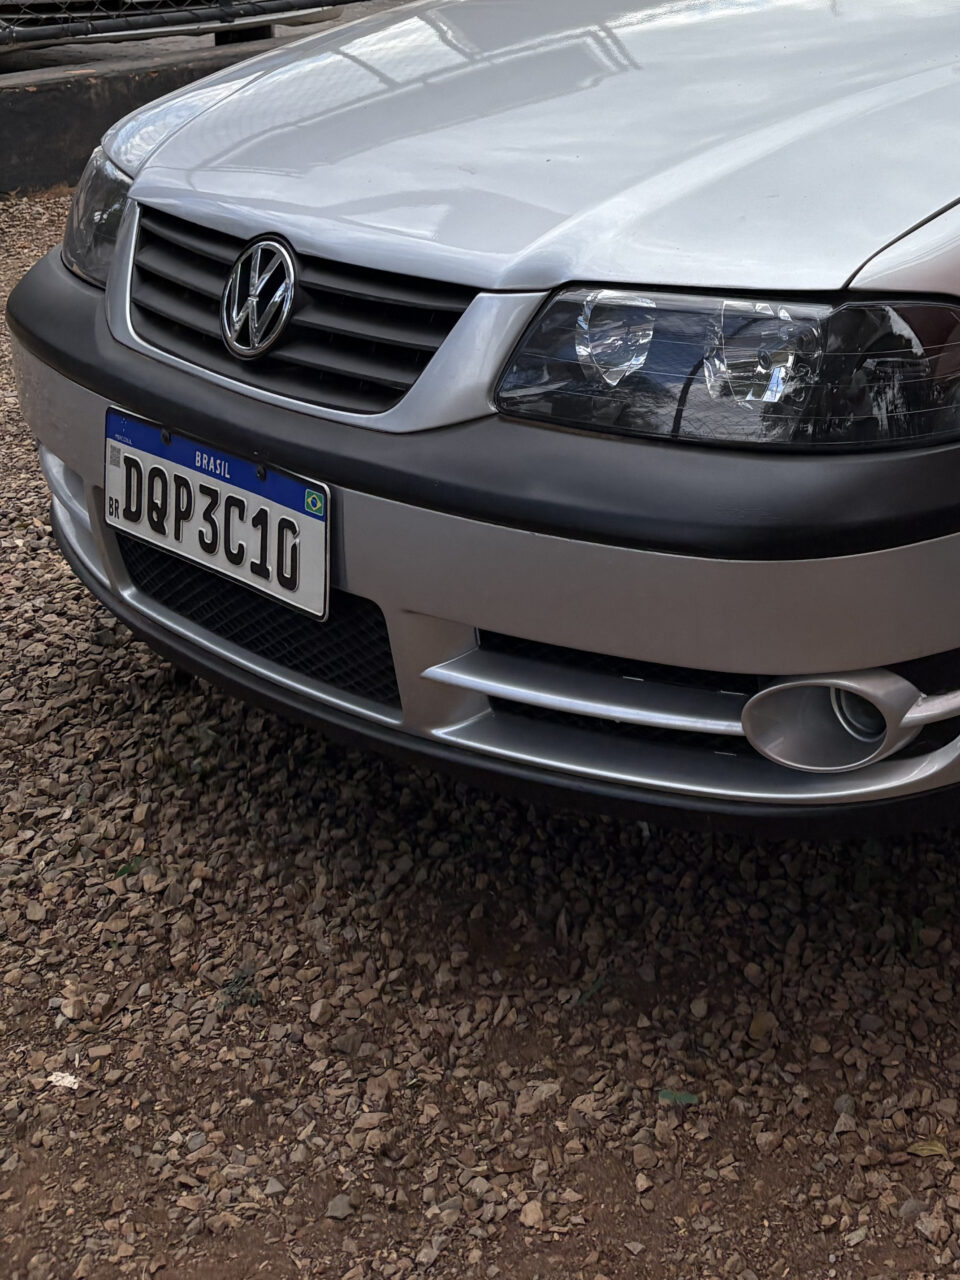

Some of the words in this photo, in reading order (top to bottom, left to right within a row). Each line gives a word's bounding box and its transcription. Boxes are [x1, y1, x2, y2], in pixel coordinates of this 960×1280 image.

[195, 451, 231, 479] BRASIL
[108, 496, 120, 520] BR
[122, 454, 300, 593] DQP3C10
